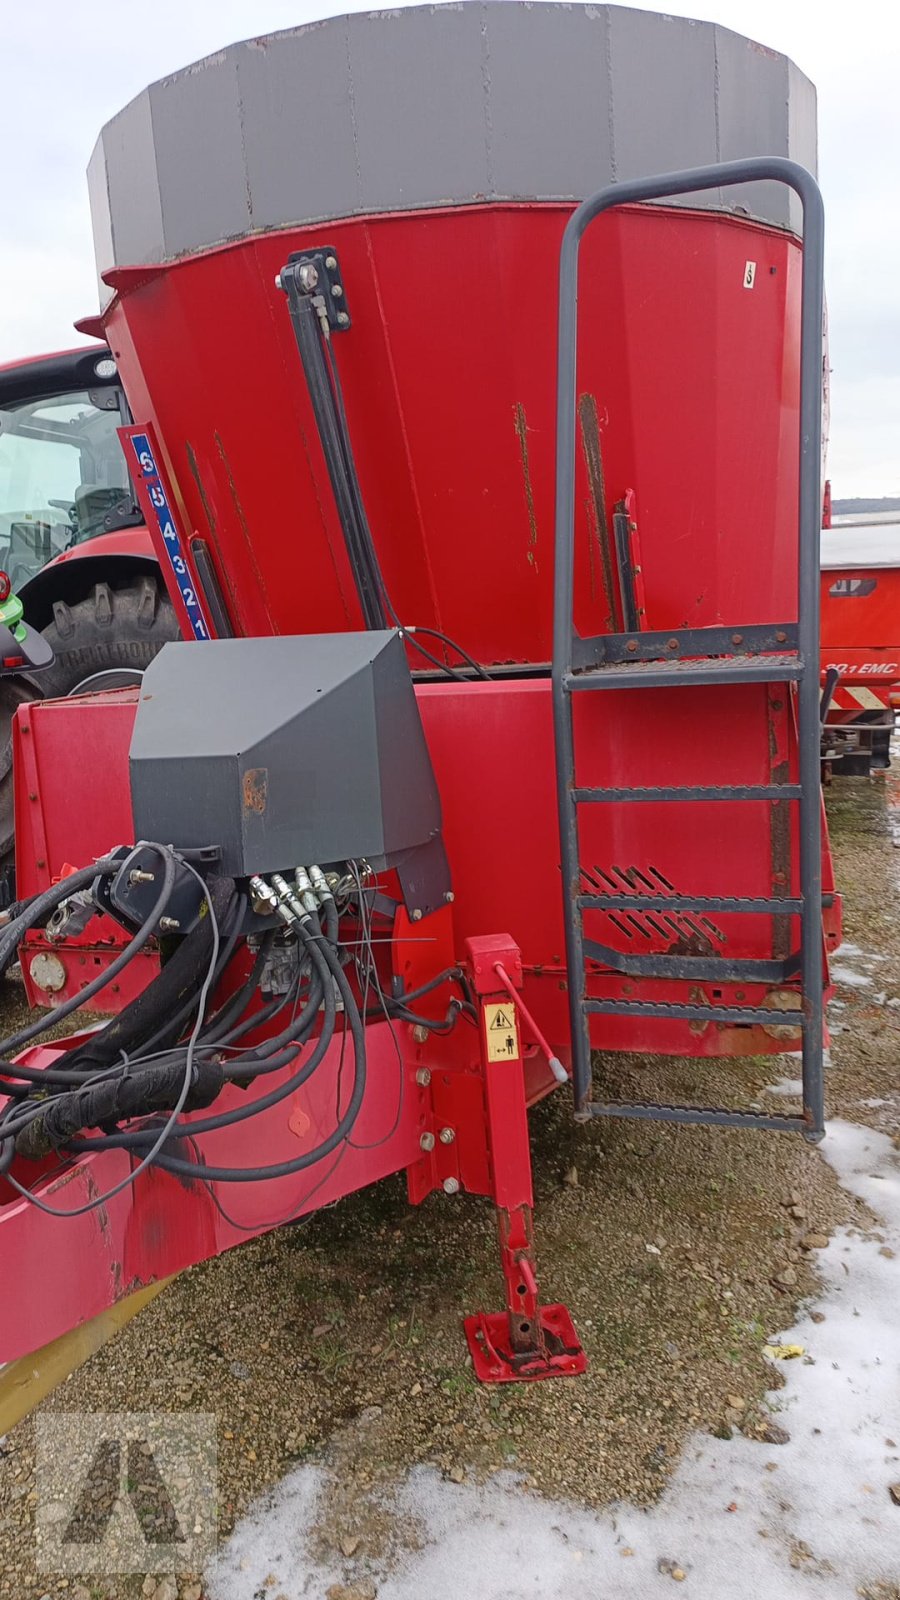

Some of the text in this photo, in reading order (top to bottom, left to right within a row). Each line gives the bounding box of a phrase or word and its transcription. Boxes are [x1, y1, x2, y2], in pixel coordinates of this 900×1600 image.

[140, 452, 154, 472] 6
[151, 487, 165, 507] 5
[163, 521, 176, 541] 4
[172, 555, 186, 574] 3
[182, 588, 196, 606] 2
[195, 620, 206, 637] 1
[857, 663, 898, 674] EMC
